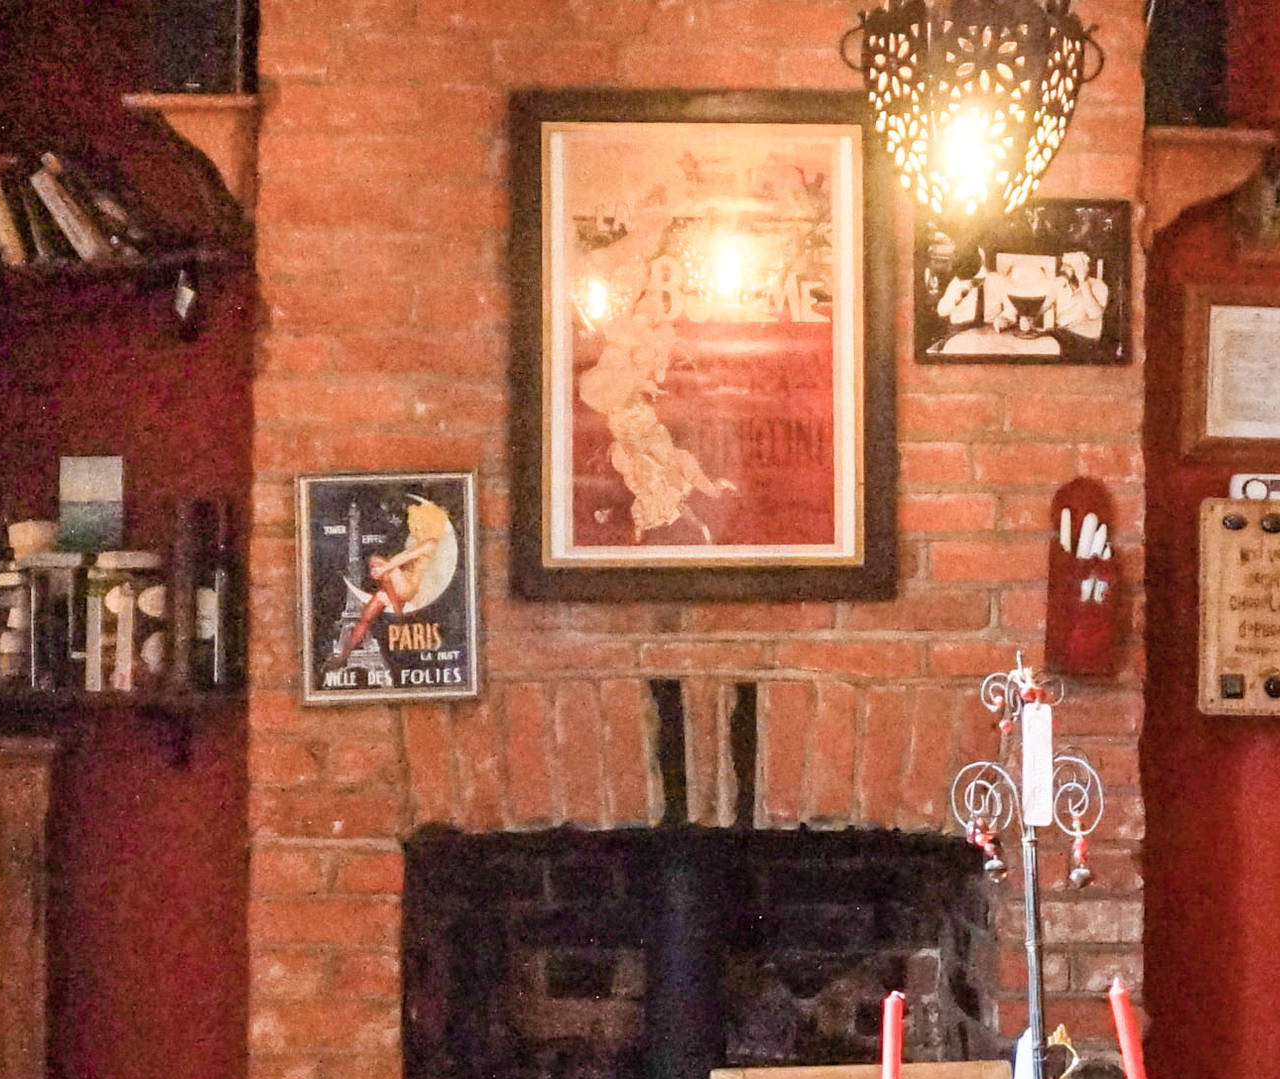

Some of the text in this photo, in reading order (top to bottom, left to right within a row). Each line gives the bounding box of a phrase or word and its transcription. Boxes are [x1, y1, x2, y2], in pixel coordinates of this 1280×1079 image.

[388, 623, 442, 651] PARIS
[367, 669, 393, 686] DES
[400, 667, 462, 684] FOLIES
